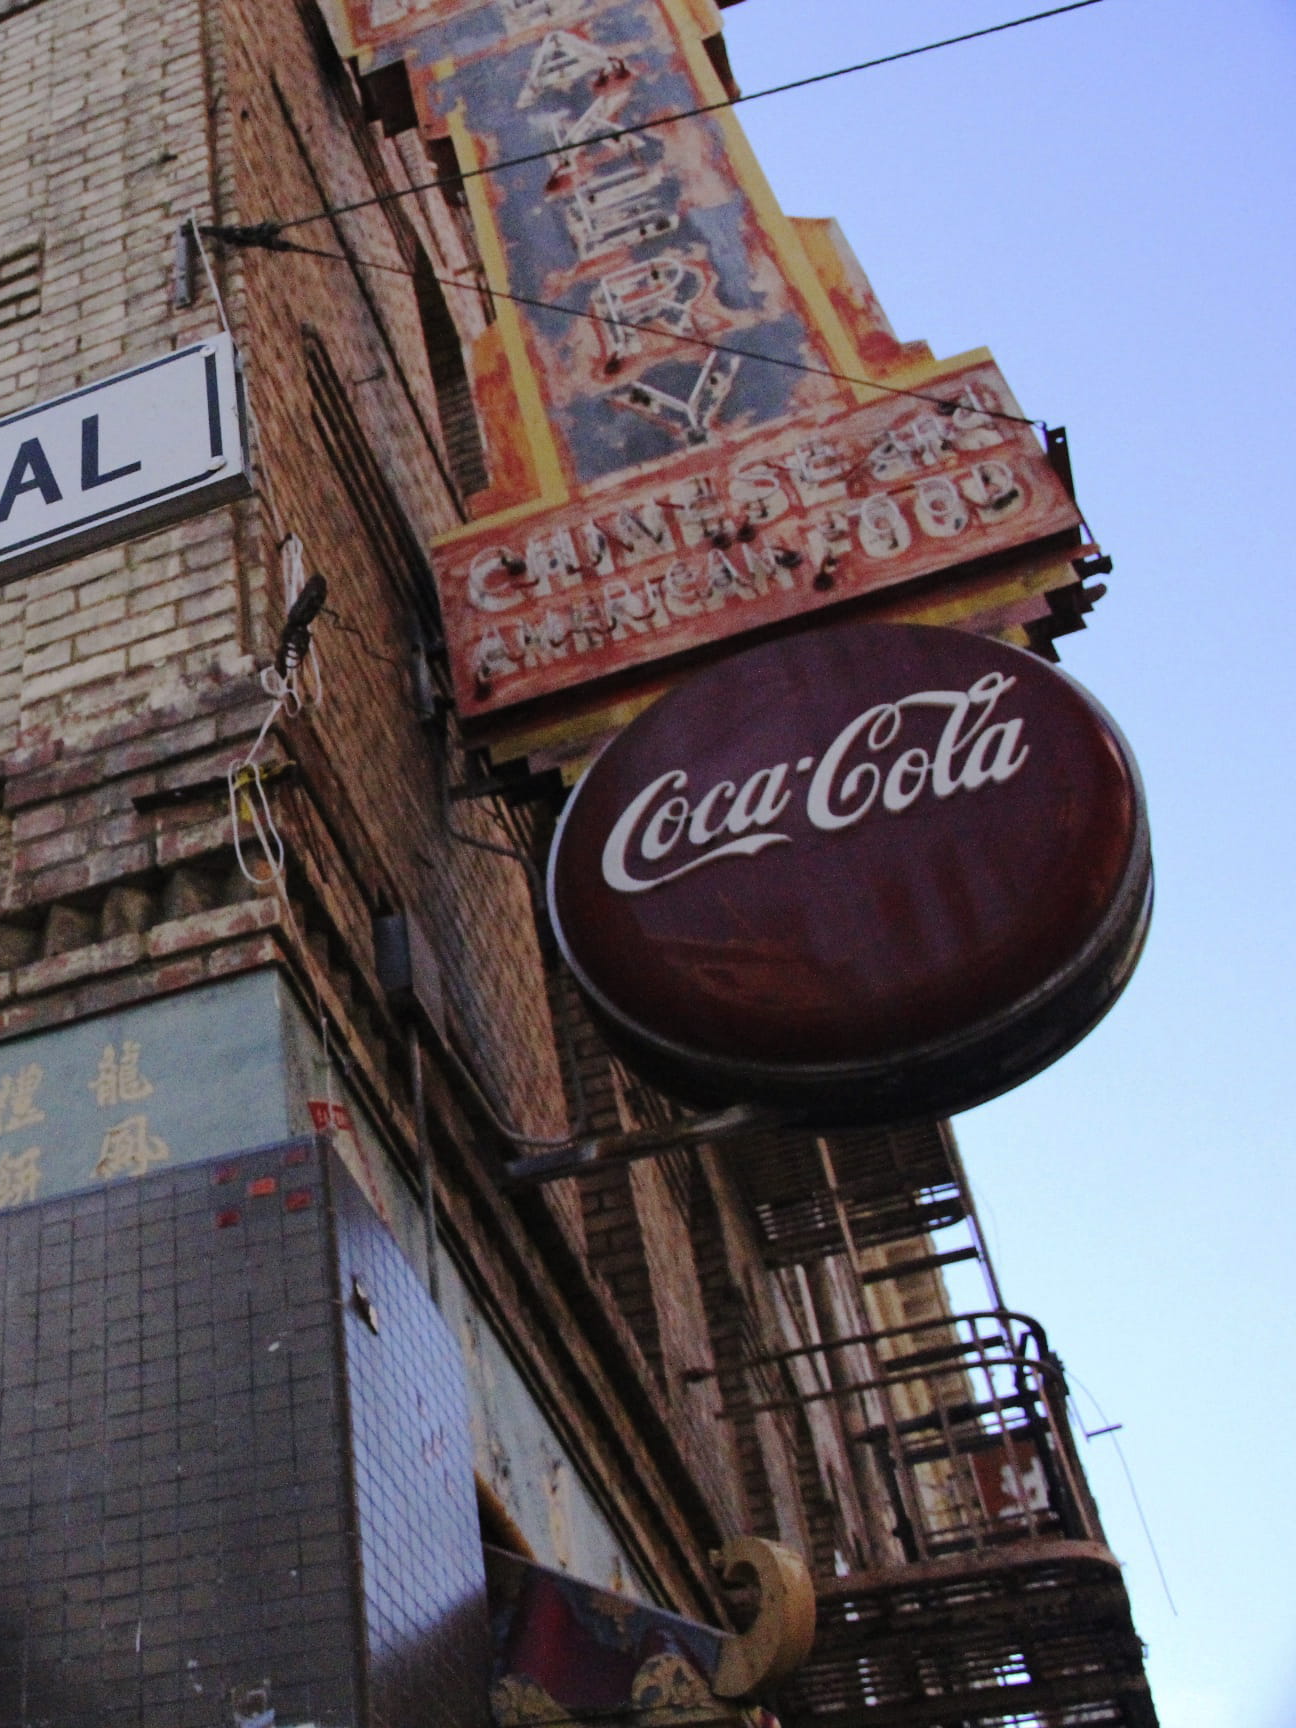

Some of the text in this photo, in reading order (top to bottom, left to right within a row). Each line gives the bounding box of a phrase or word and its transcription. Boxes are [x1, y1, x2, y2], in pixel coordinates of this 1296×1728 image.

[504, 0, 740, 446] AKERY
[467, 442, 848, 613] CHINESE
[472, 459, 1026, 681] AMERICAN FOOD
[601, 671, 1031, 893] Coca-Cola
